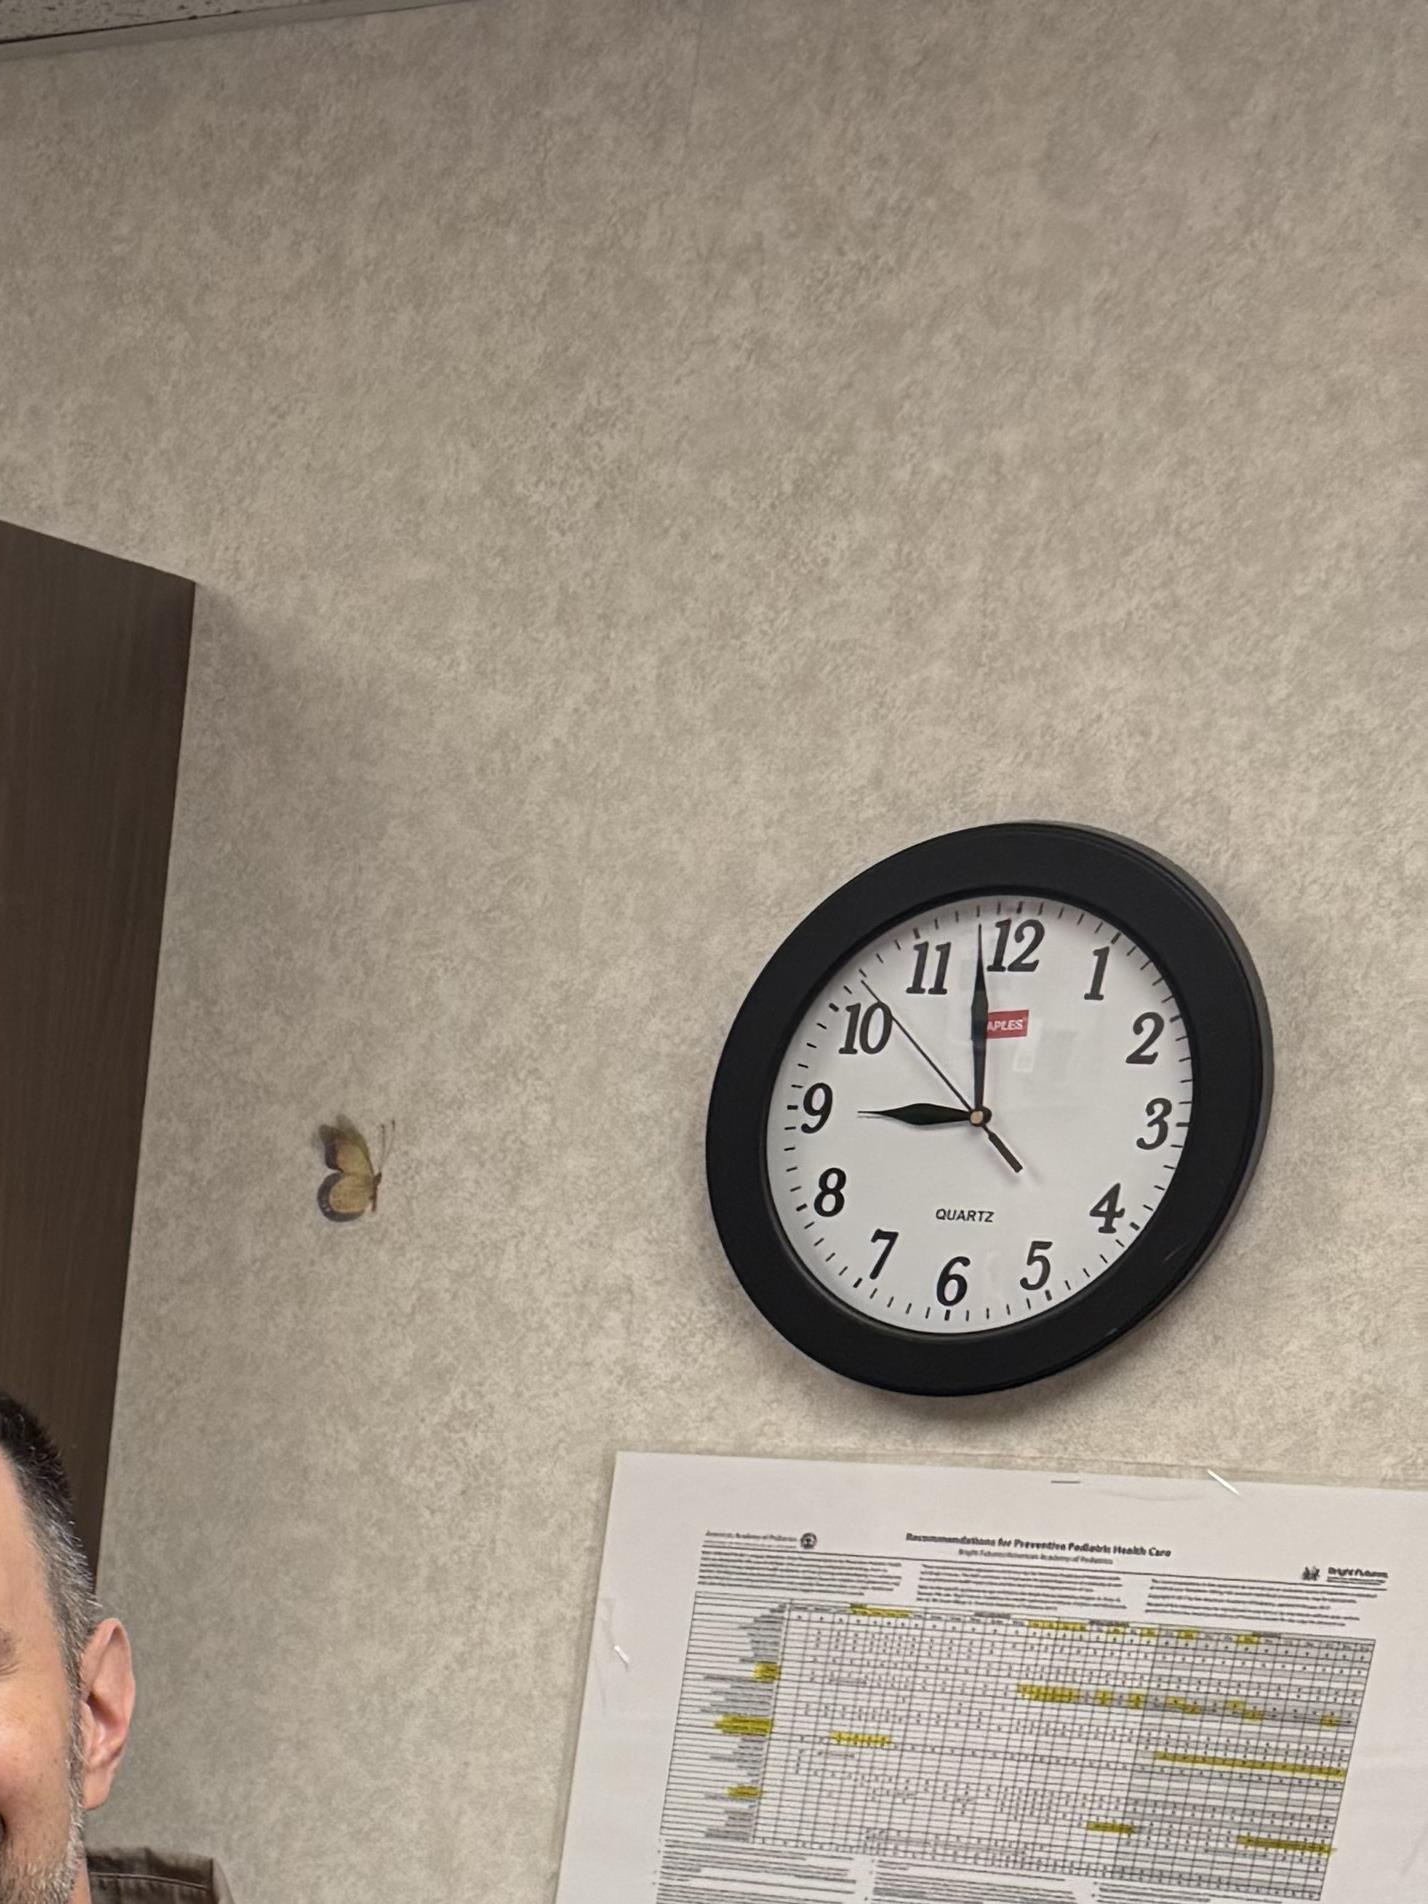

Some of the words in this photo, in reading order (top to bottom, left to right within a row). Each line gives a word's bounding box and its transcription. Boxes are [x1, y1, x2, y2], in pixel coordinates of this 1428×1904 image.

[906, 941, 952, 996] 11
[986, 919, 1044, 973] 12
[1084, 946, 1111, 1000] 1
[839, 1001, 892, 1055] 10
[986, 1020, 1023, 1033] APLES
[1125, 1011, 1164, 1065] 2
[801, 1082, 833, 1134] 9
[1136, 1097, 1172, 1150] 3
[813, 1167, 846, 1217] 8
[934, 1208, 994, 1223] QUARTZ
[1089, 1182, 1125, 1234] 4
[869, 1229, 898, 1280] 7
[1020, 1240, 1053, 1291] 5
[936, 1256, 968, 1307] 6
